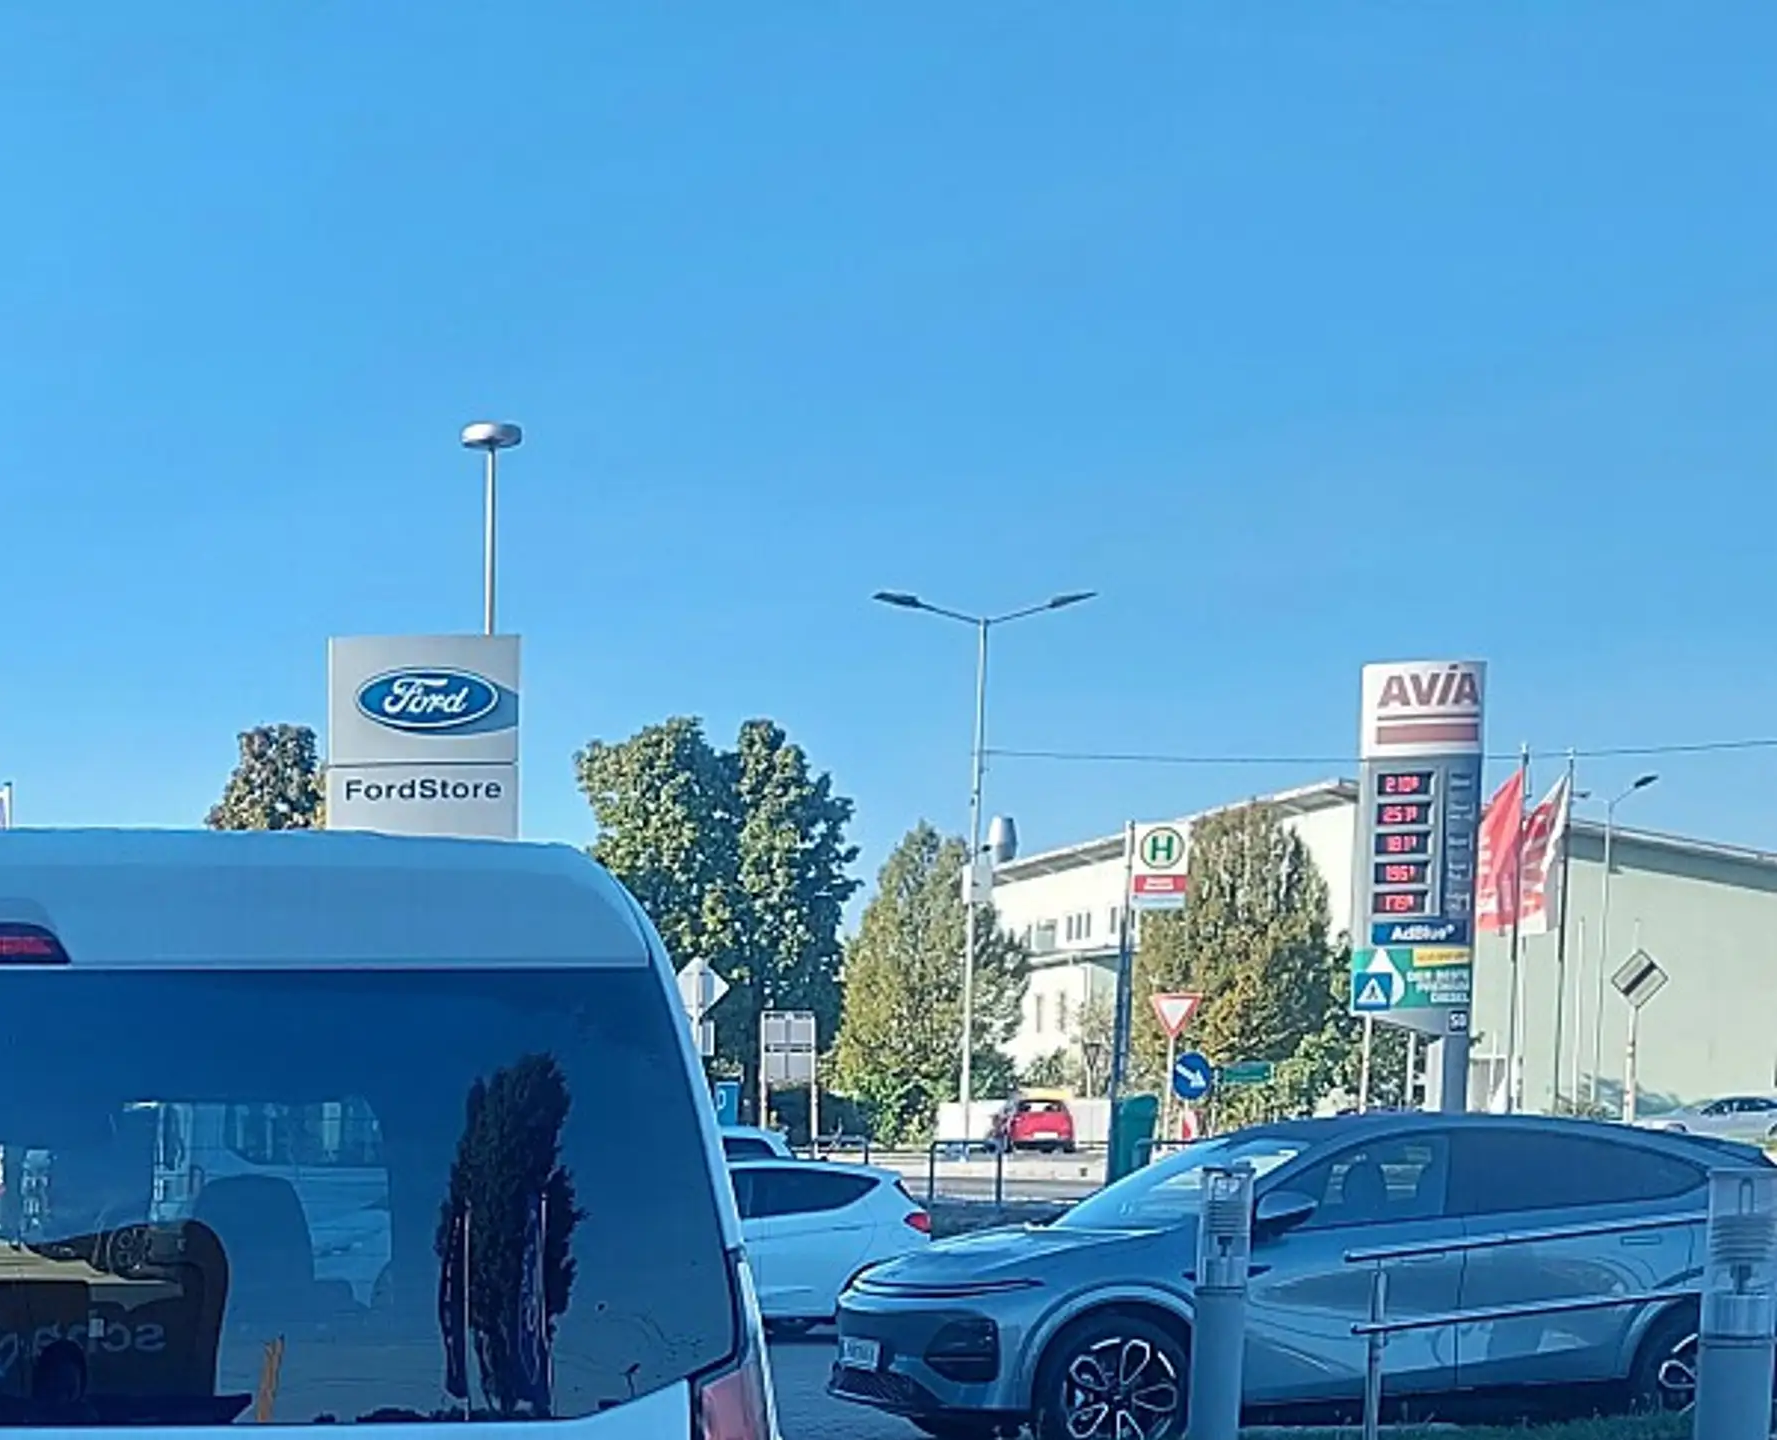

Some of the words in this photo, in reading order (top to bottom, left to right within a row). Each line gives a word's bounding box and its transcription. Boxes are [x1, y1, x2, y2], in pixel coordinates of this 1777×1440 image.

[383, 678, 469, 714] Ford
[345, 779, 502, 801] FordStore
[1151, 835, 1174, 861] H
